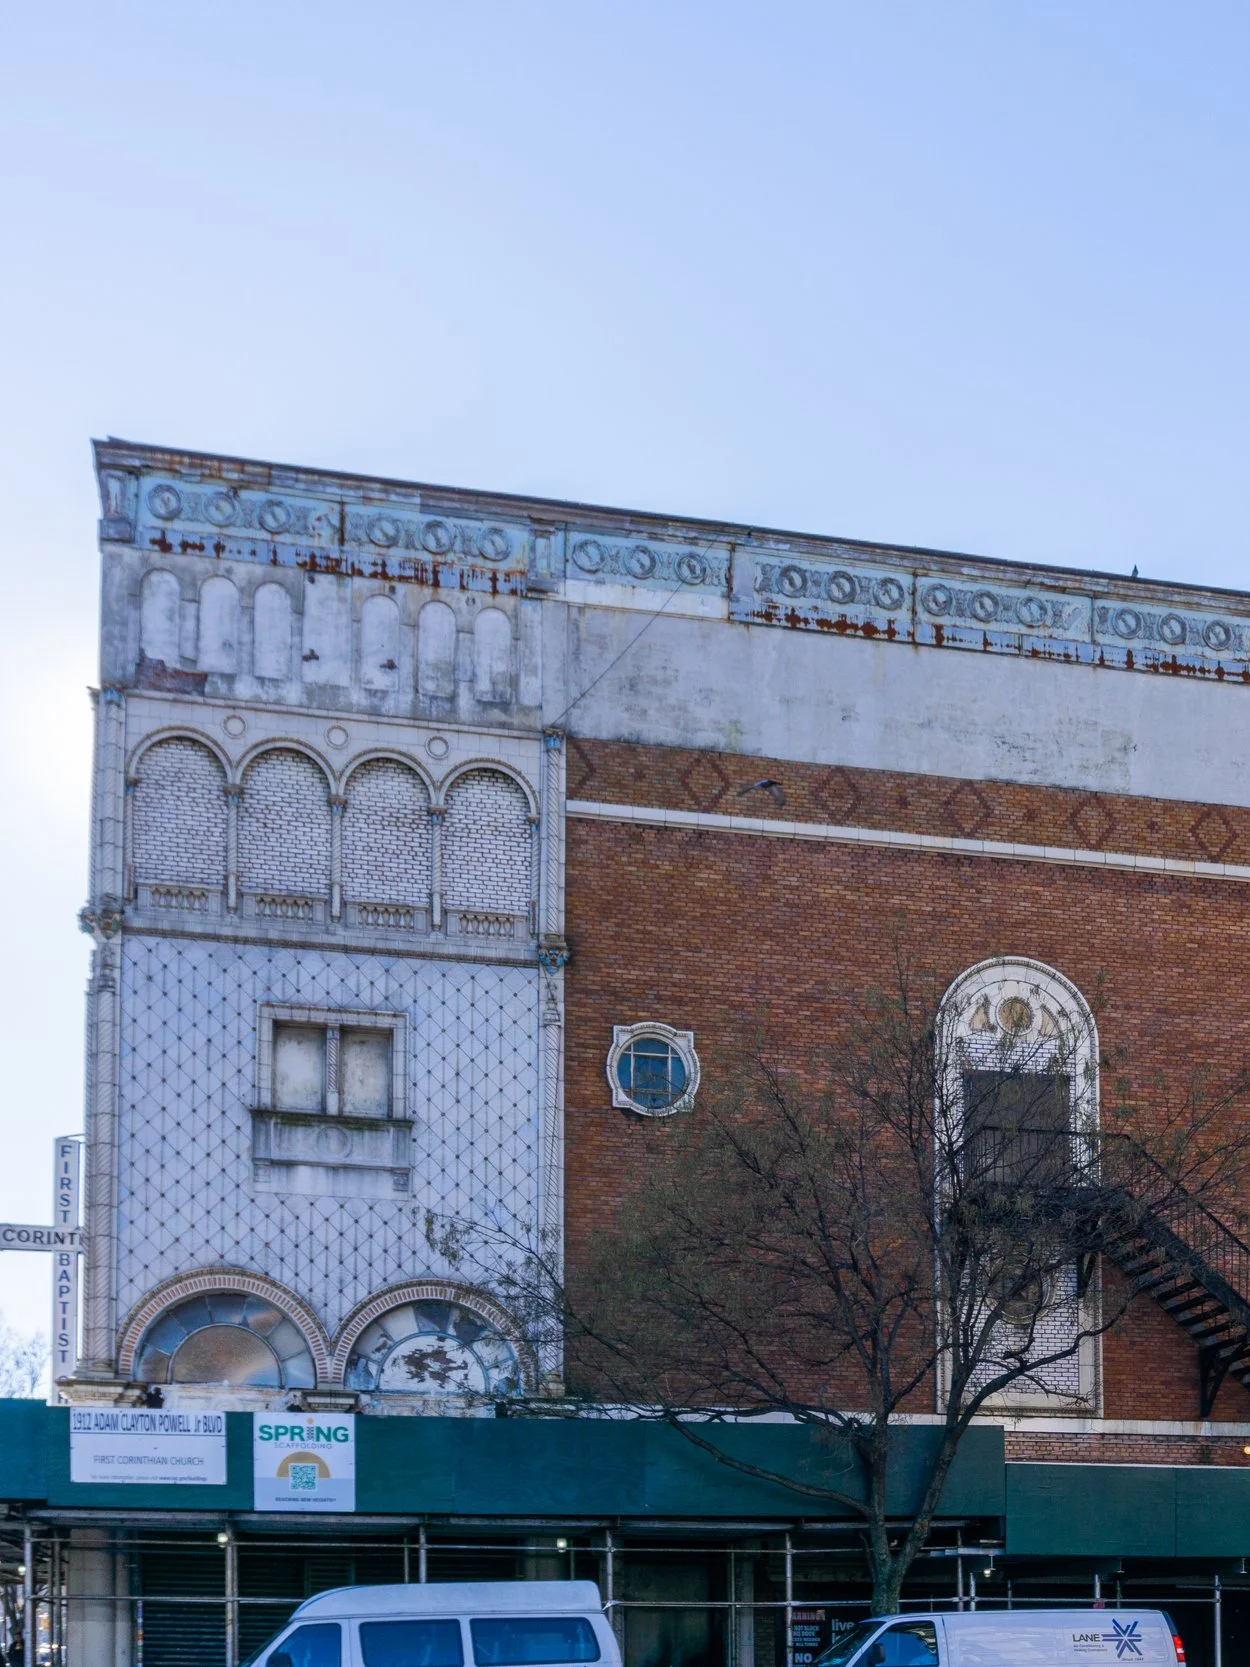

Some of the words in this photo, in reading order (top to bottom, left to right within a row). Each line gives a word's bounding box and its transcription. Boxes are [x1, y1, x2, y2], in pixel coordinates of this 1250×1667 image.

[59, 1144, 72, 1223] FIRST
[2, 1228, 83, 1246] CORINT
[58, 1253, 71, 1364] BAPTIST
[73, 1413, 91, 1430] 1912
[93, 1413, 119, 1431] ADAM
[121, 1414, 157, 1431] CLAYTON
[159, 1415, 191, 1433] POWELL
[203, 1416, 222, 1433] BLVD
[258, 1417, 349, 1443] SPRING
[94, 1455, 115, 1464] FIRST
[117, 1456, 168, 1465] CORINTHIAN
[170, 1457, 204, 1466] CHURCH
[832, 1618, 855, 1631] live
[1072, 1634, 1101, 1642] LANE
[794, 1652, 813, 1663] NO
